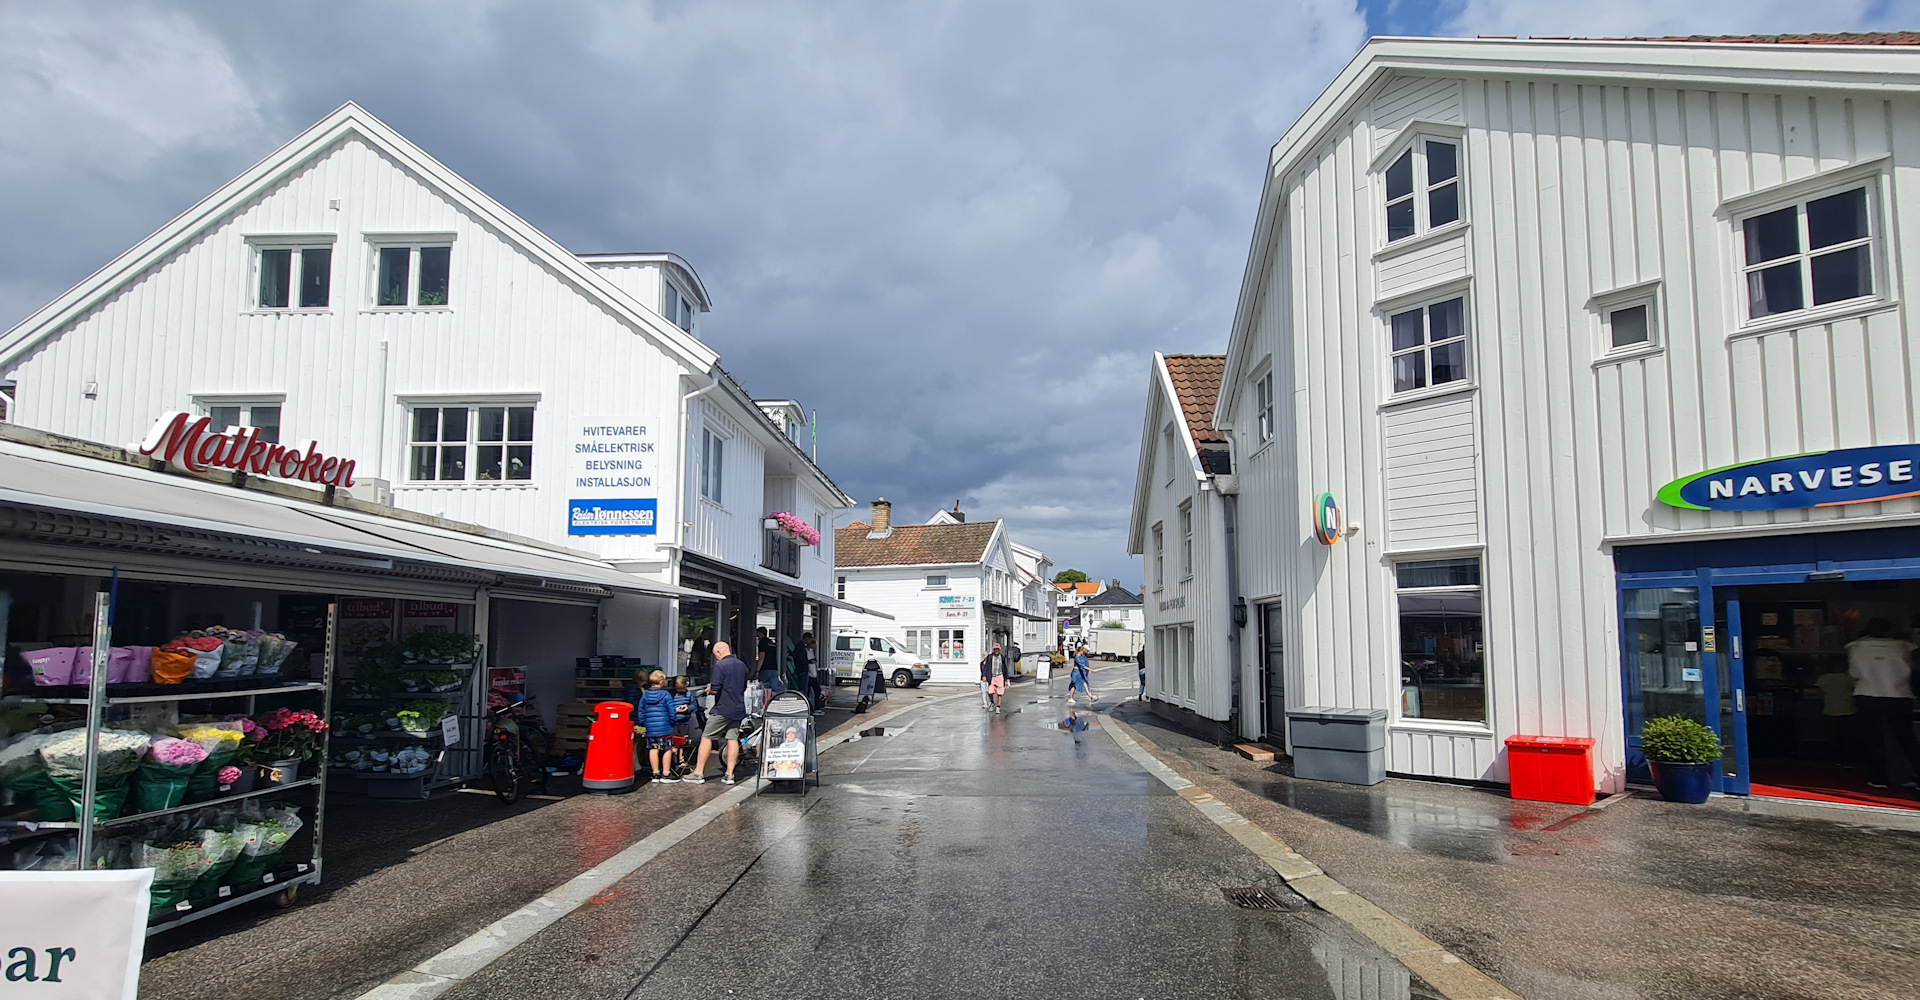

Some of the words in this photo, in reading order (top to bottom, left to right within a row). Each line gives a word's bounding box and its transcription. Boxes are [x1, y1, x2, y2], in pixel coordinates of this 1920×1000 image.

[583, 425, 647, 436] HVITEVARER
[139, 412, 356, 488] Matkroken
[575, 440, 655, 453] SMÅELEKTRISK
[585, 460, 643, 470] BELYSNING
[576, 477, 651, 487] INSTALLASJON
[592, 506, 655, 521] Tønnessen
[1325, 505, 1337, 531] N
[0, 946, 77, 983] ar
